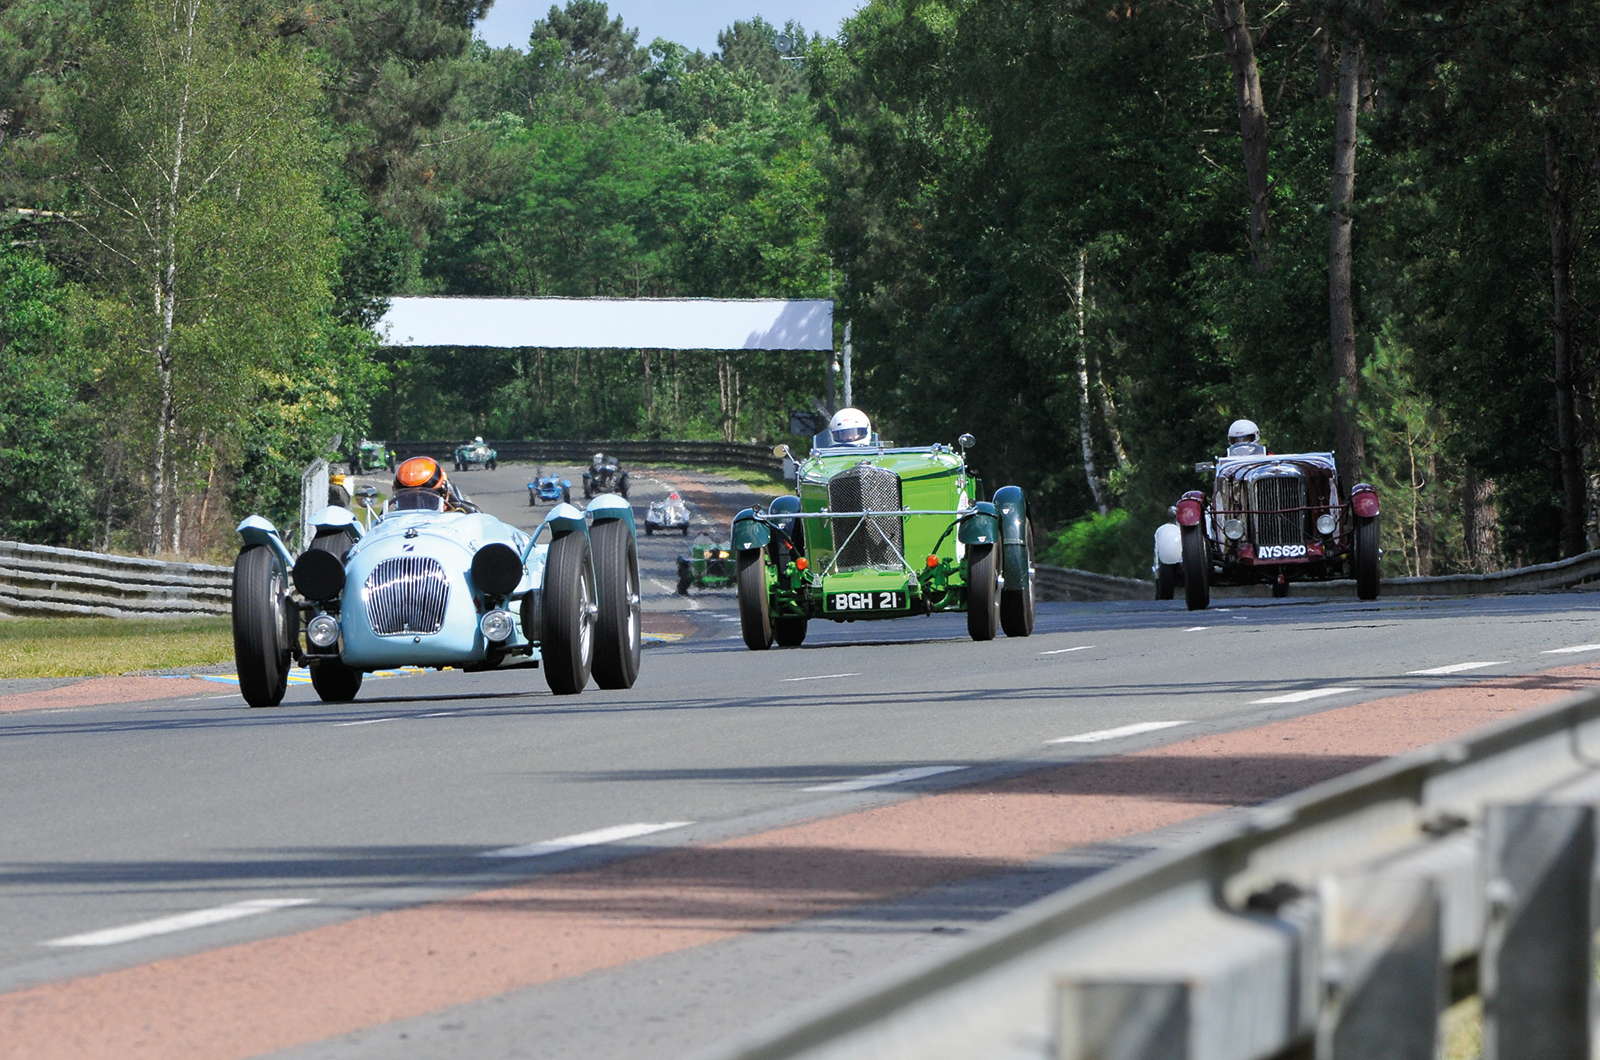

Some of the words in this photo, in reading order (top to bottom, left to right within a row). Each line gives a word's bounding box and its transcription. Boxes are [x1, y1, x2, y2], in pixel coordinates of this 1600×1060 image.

[1258, 545, 1306, 558] AYS620
[835, 593, 873, 610] BGH
[879, 592, 897, 609] 21
